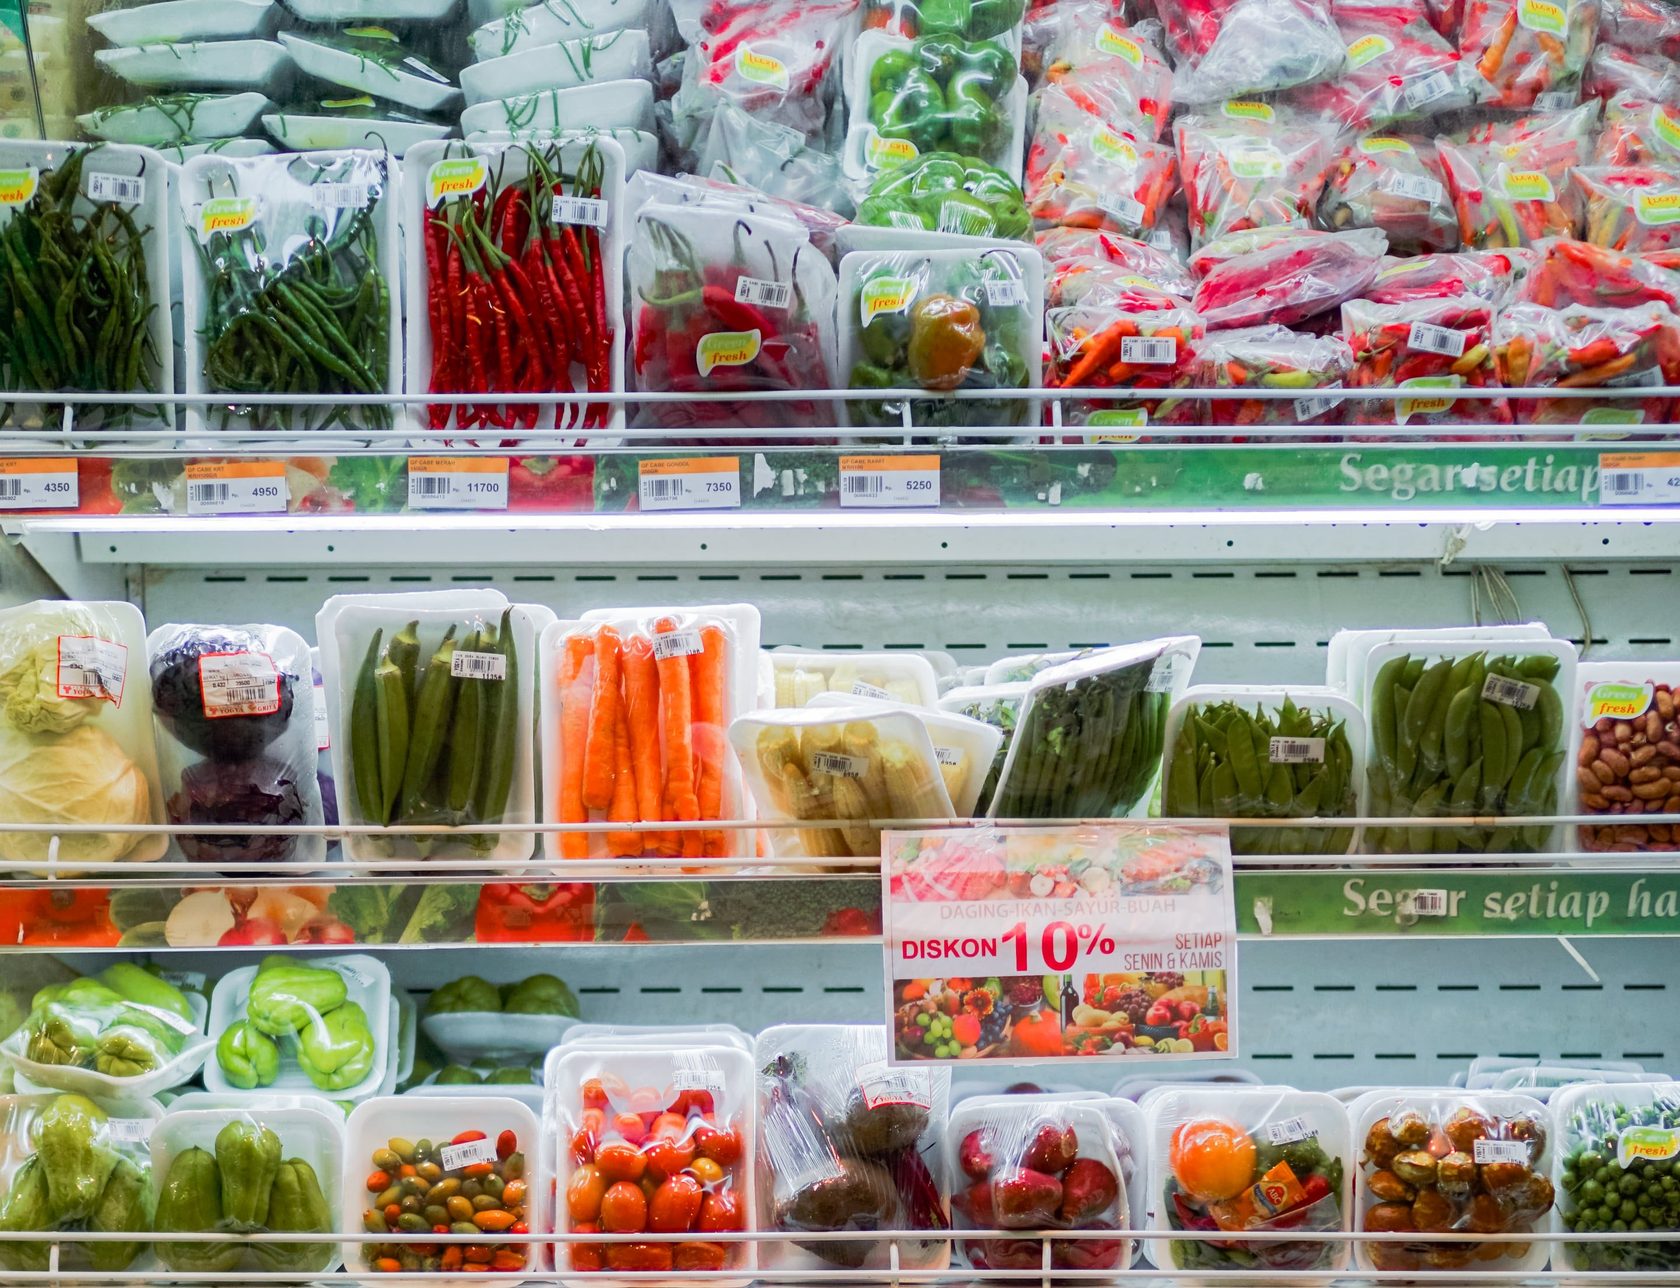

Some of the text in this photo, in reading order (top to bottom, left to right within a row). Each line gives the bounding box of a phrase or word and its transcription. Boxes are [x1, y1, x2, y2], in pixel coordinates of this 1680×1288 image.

[440, 179, 474, 193] fresh
[211, 217, 245, 229] fresh
[873, 297, 905, 310] fresh
[712, 351, 748, 364] fresh
[1410, 398, 1446, 412] fresh
[1339, 453, 1600, 502] Segar setiap
[44, 482, 70, 492] 4350
[467, 483, 500, 492] 11700
[706, 482, 732, 492] 7350
[906, 480, 932, 490] 5250
[252, 487, 278, 497] 4950
[219, 705, 244, 714] YOGYA
[1600, 703, 1636, 715] fresh
[939, 898, 1177, 921] DAGING-IKAN-SAYUR-BUAH
[1342, 878, 1467, 926] Segr
[1483, 880, 1610, 928] setiap
[901, 920, 1116, 972] DISKON 10%
[1175, 931, 1223, 950] SETIAP
[1124, 951, 1223, 971] SENIN & KAMIS
[1632, 1143, 1668, 1156] fresh
[1267, 1188, 1282, 1204] ABC
